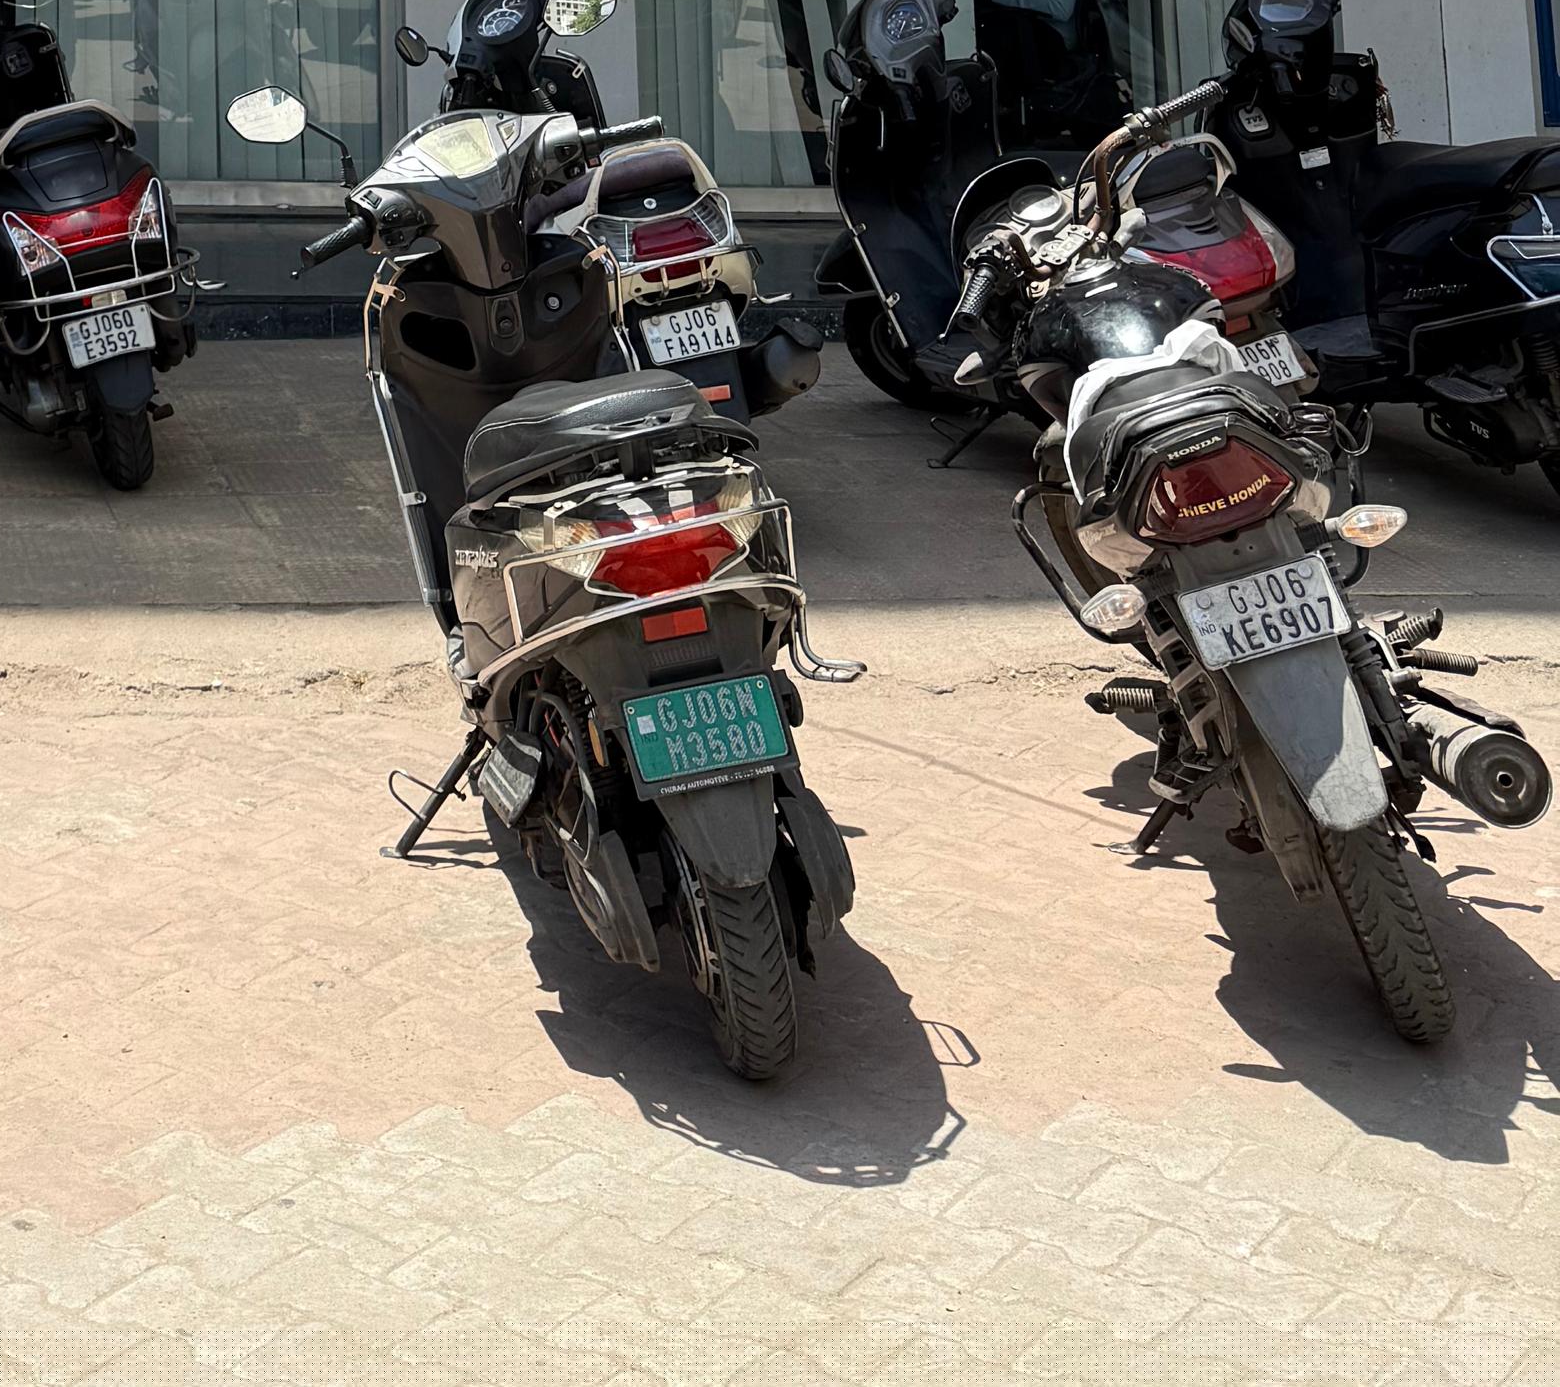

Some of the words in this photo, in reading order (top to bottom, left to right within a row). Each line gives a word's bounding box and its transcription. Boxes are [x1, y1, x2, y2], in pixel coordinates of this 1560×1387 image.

[669, 308, 716, 334] GJ06
[84, 329, 139, 360] E3592
[664, 325, 734, 358] FA9144
[1167, 435, 1221, 460] HONDA
[1228, 474, 1271, 505] HONDA
[1228, 568, 1306, 615] GJ06
[1223, 596, 1336, 657] KE6907
